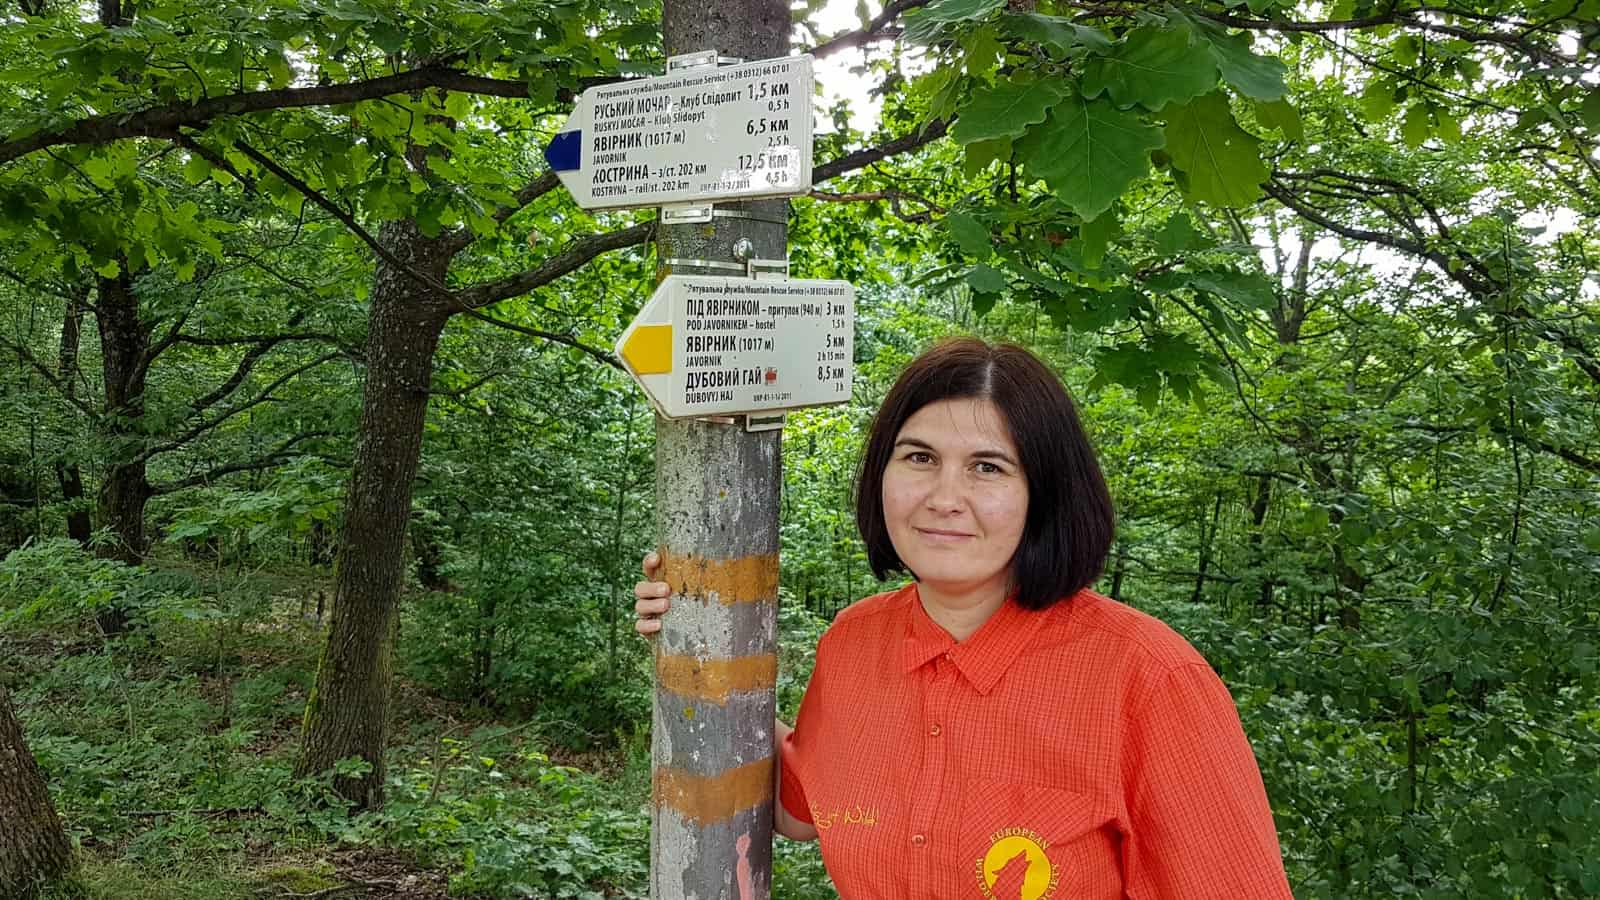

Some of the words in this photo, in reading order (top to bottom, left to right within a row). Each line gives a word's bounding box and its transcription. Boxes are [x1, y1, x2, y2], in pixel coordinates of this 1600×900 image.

[683, 77, 702, 87] Rescue
[704, 73, 726, 84] Service
[744, 68, 761, 79] 0312)
[763, 66, 771, 75] 66
[772, 65, 780, 74] 07
[782, 64, 789, 72] 01
[748, 82, 766, 100] 1,5
[594, 98, 634, 120] РУСЬКИЙ
[637, 95, 670, 113] МОЧАР
[681, 93, 700, 110] Клуб
[702, 91, 741, 106] Слідопит
[768, 101, 781, 112] 0,5
[784, 99, 789, 109] h
[594, 119, 619, 133] RUSKYJ
[655, 113, 671, 125] Klub
[673, 110, 705, 123] Slidopyt
[747, 118, 766, 136] 6,5
[593, 132, 642, 152] ЯВІРНИК
[645, 131, 671, 148] (1017
[768, 136, 781, 147] 2,5
[784, 135, 789, 145] h
[593, 152, 627, 165] JAVORNIK
[738, 153, 765, 172] 12,5
[679, 163, 693, 176] 202
[766, 171, 780, 184] 4,5
[782, 170, 788, 182] h
[592, 184, 627, 197] KOSTRYNA
[662, 181, 676, 191] 202
[678, 179, 689, 190] km
[687, 299, 704, 319] ПІД
[706, 299, 760, 316] ЯВІРНИКОМ
[768, 305, 799, 319] притулок
[826, 301, 831, 315] 3
[687, 320, 701, 330] POD
[703, 320, 748, 330] JAVORNIKEM
[756, 319, 775, 329] hostel
[686, 336, 736, 352] ЯВІРНИК
[739, 337, 762, 352] (1017
[826, 333, 831, 348] 5
[686, 355, 721, 367] JAVORNIK
[827, 351, 833, 360] 15
[834, 350, 845, 360] min
[686, 367, 739, 392] ДУБОВИЙ
[743, 366, 761, 385] ГАЙ
[818, 365, 830, 382] 8,5
[686, 391, 719, 404] DUBOVYJ
[720, 390, 733, 400] HAJ
[990, 827, 1050, 850] EUROPEAN
